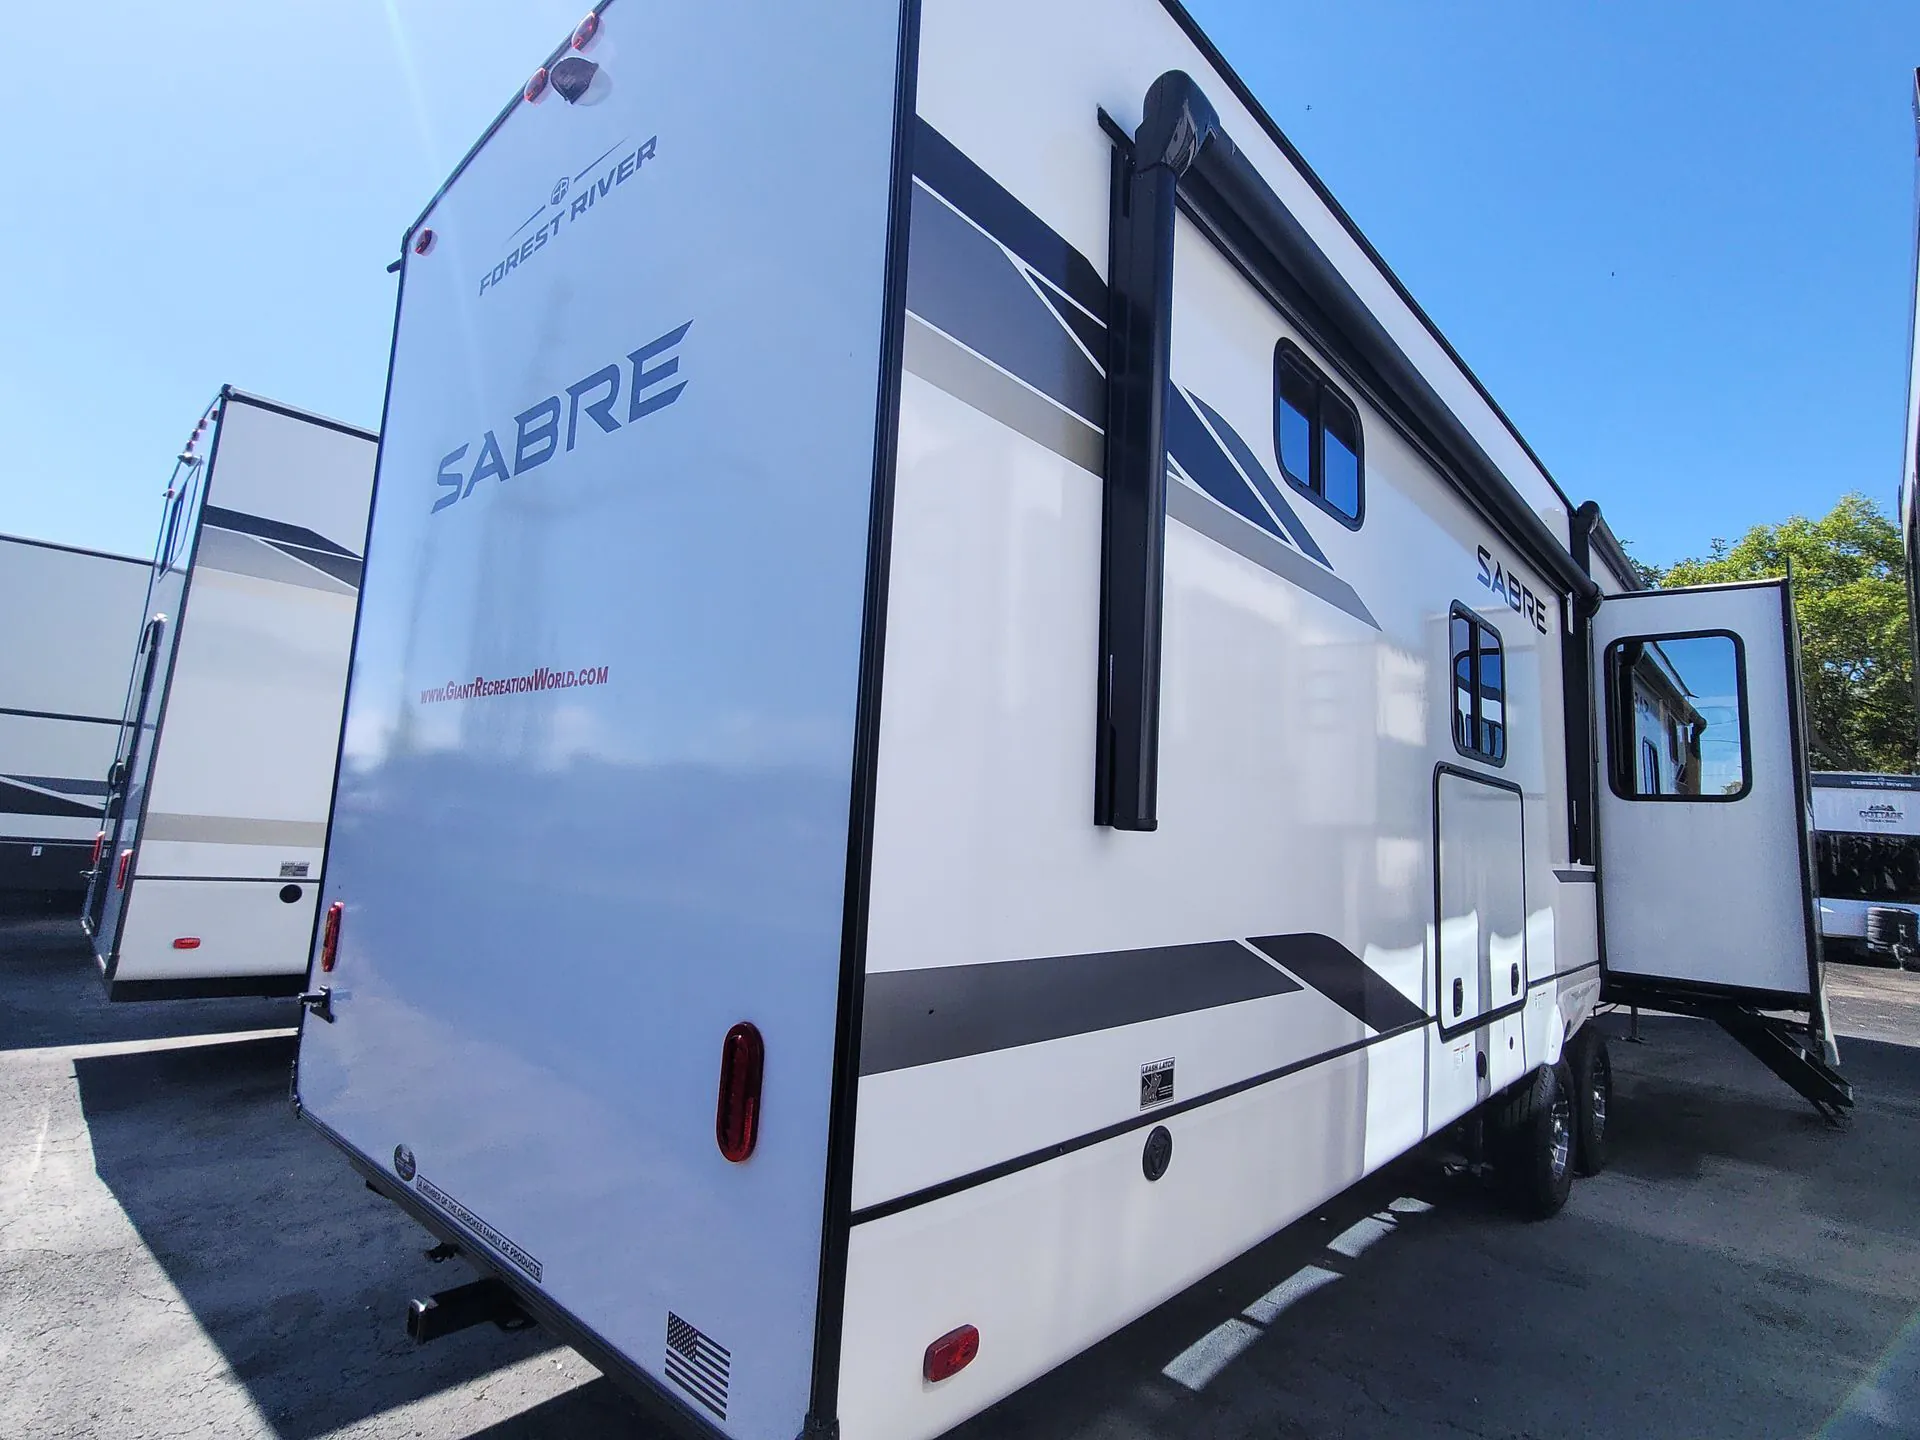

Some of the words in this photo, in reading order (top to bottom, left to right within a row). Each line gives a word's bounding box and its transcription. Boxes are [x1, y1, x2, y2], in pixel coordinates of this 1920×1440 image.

[479, 209, 565, 296] FOREST
[570, 135, 657, 222] RIVER
[430, 318, 694, 514] SABRE
[1476, 544, 1547, 635] SABRE
[1142, 1063, 1158, 1073] LEASH
[1159, 1060, 1175, 1069] LATCH
[457, 1207, 484, 1233] CHEROKEE
[482, 1226, 502, 1246] FAMILY
[501, 1241, 510, 1253] OF
[510, 1247, 541, 1278] PRODUCTS
